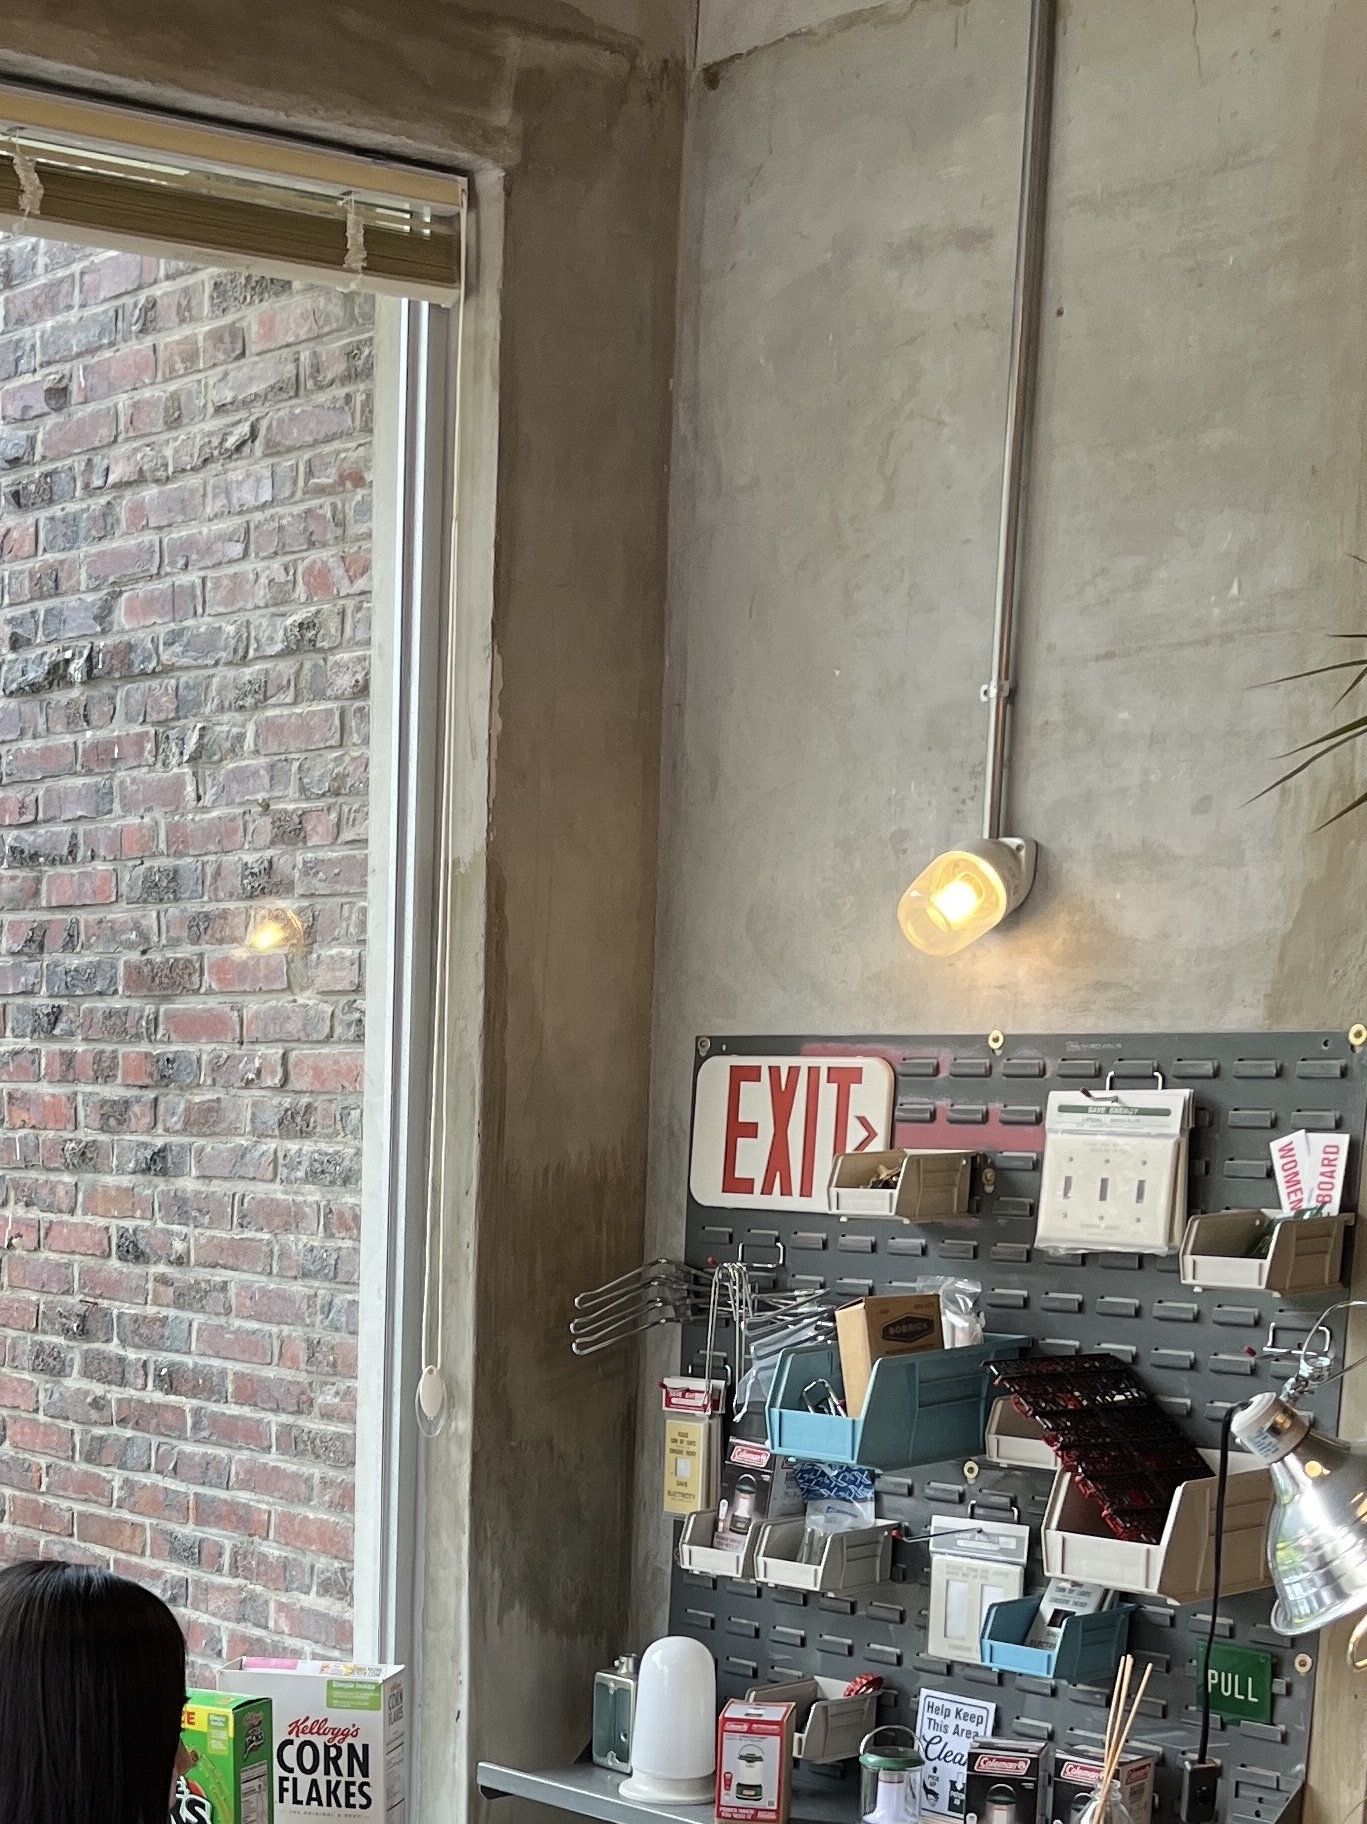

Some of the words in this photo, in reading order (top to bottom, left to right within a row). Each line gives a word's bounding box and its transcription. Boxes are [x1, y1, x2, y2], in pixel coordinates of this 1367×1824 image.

[722, 1065, 863, 1198] EXIT
[1278, 1140, 1305, 1212] WOMEN
[1316, 1144, 1340, 1204] BOARD
[1208, 1668, 1258, 1702] PULL
[288, 1715, 360, 1744] Kellogg's
[926, 1700, 951, 1719] Help
[955, 1707, 984, 1727] Keep
[926, 1717, 949, 1734] This
[952, 1723, 979, 1740] Area
[277, 1739, 369, 1778] CORN
[922, 1734, 968, 1766] Clea
[980, 1757, 1017, 1770] Coleman
[278, 1776, 372, 1810] FLAKES
